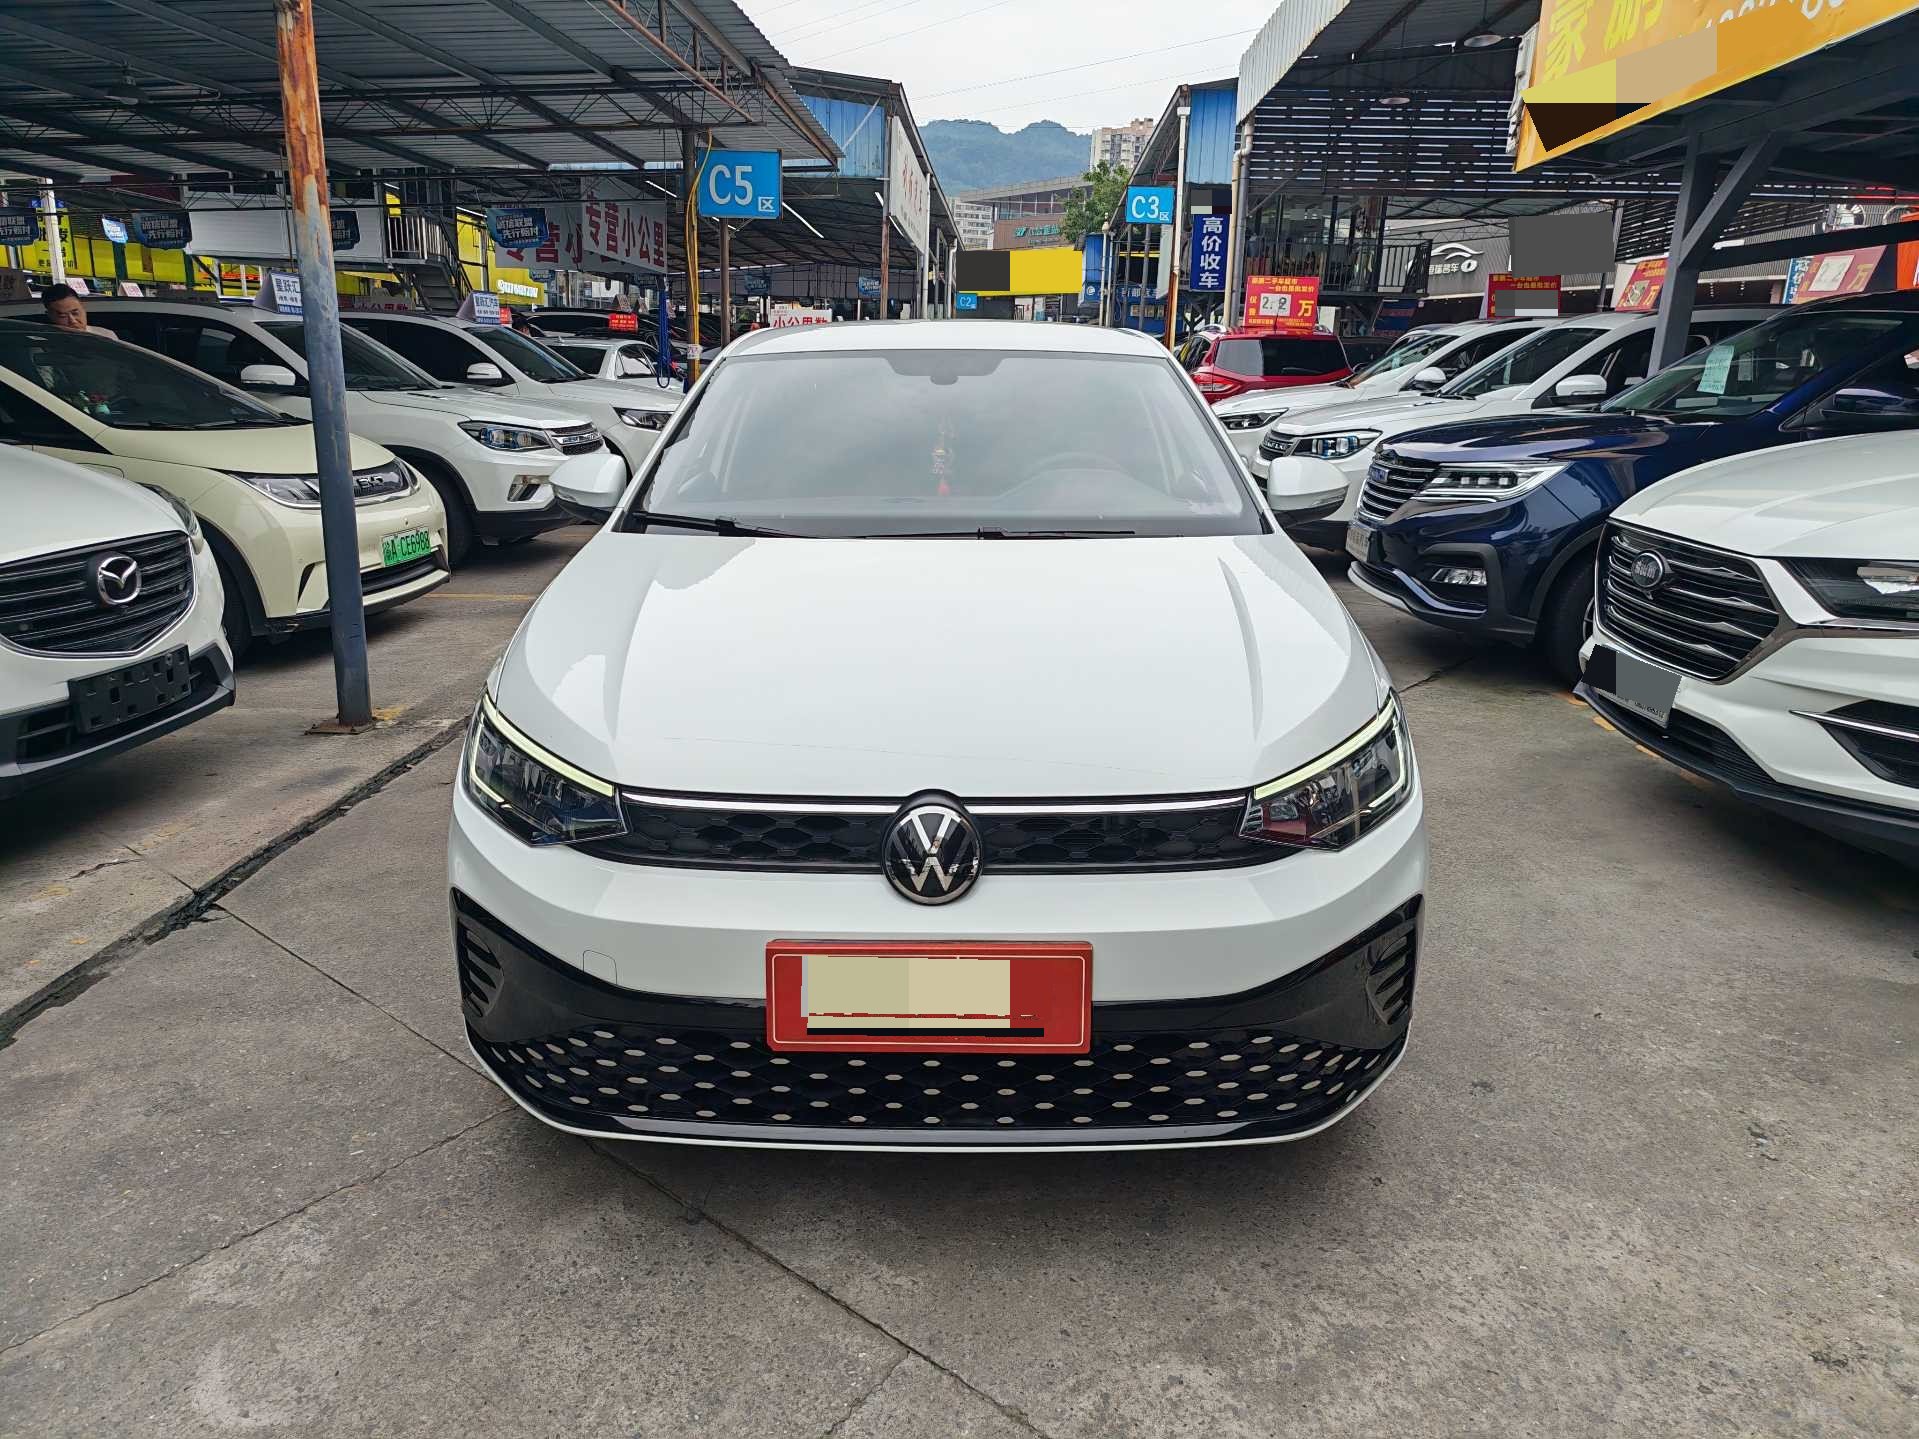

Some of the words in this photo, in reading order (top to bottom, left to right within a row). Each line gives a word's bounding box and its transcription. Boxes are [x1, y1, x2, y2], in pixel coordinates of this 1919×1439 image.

[1199, 217, 1223, 288] 高价收车
[1297, 300, 1315, 317] 万
